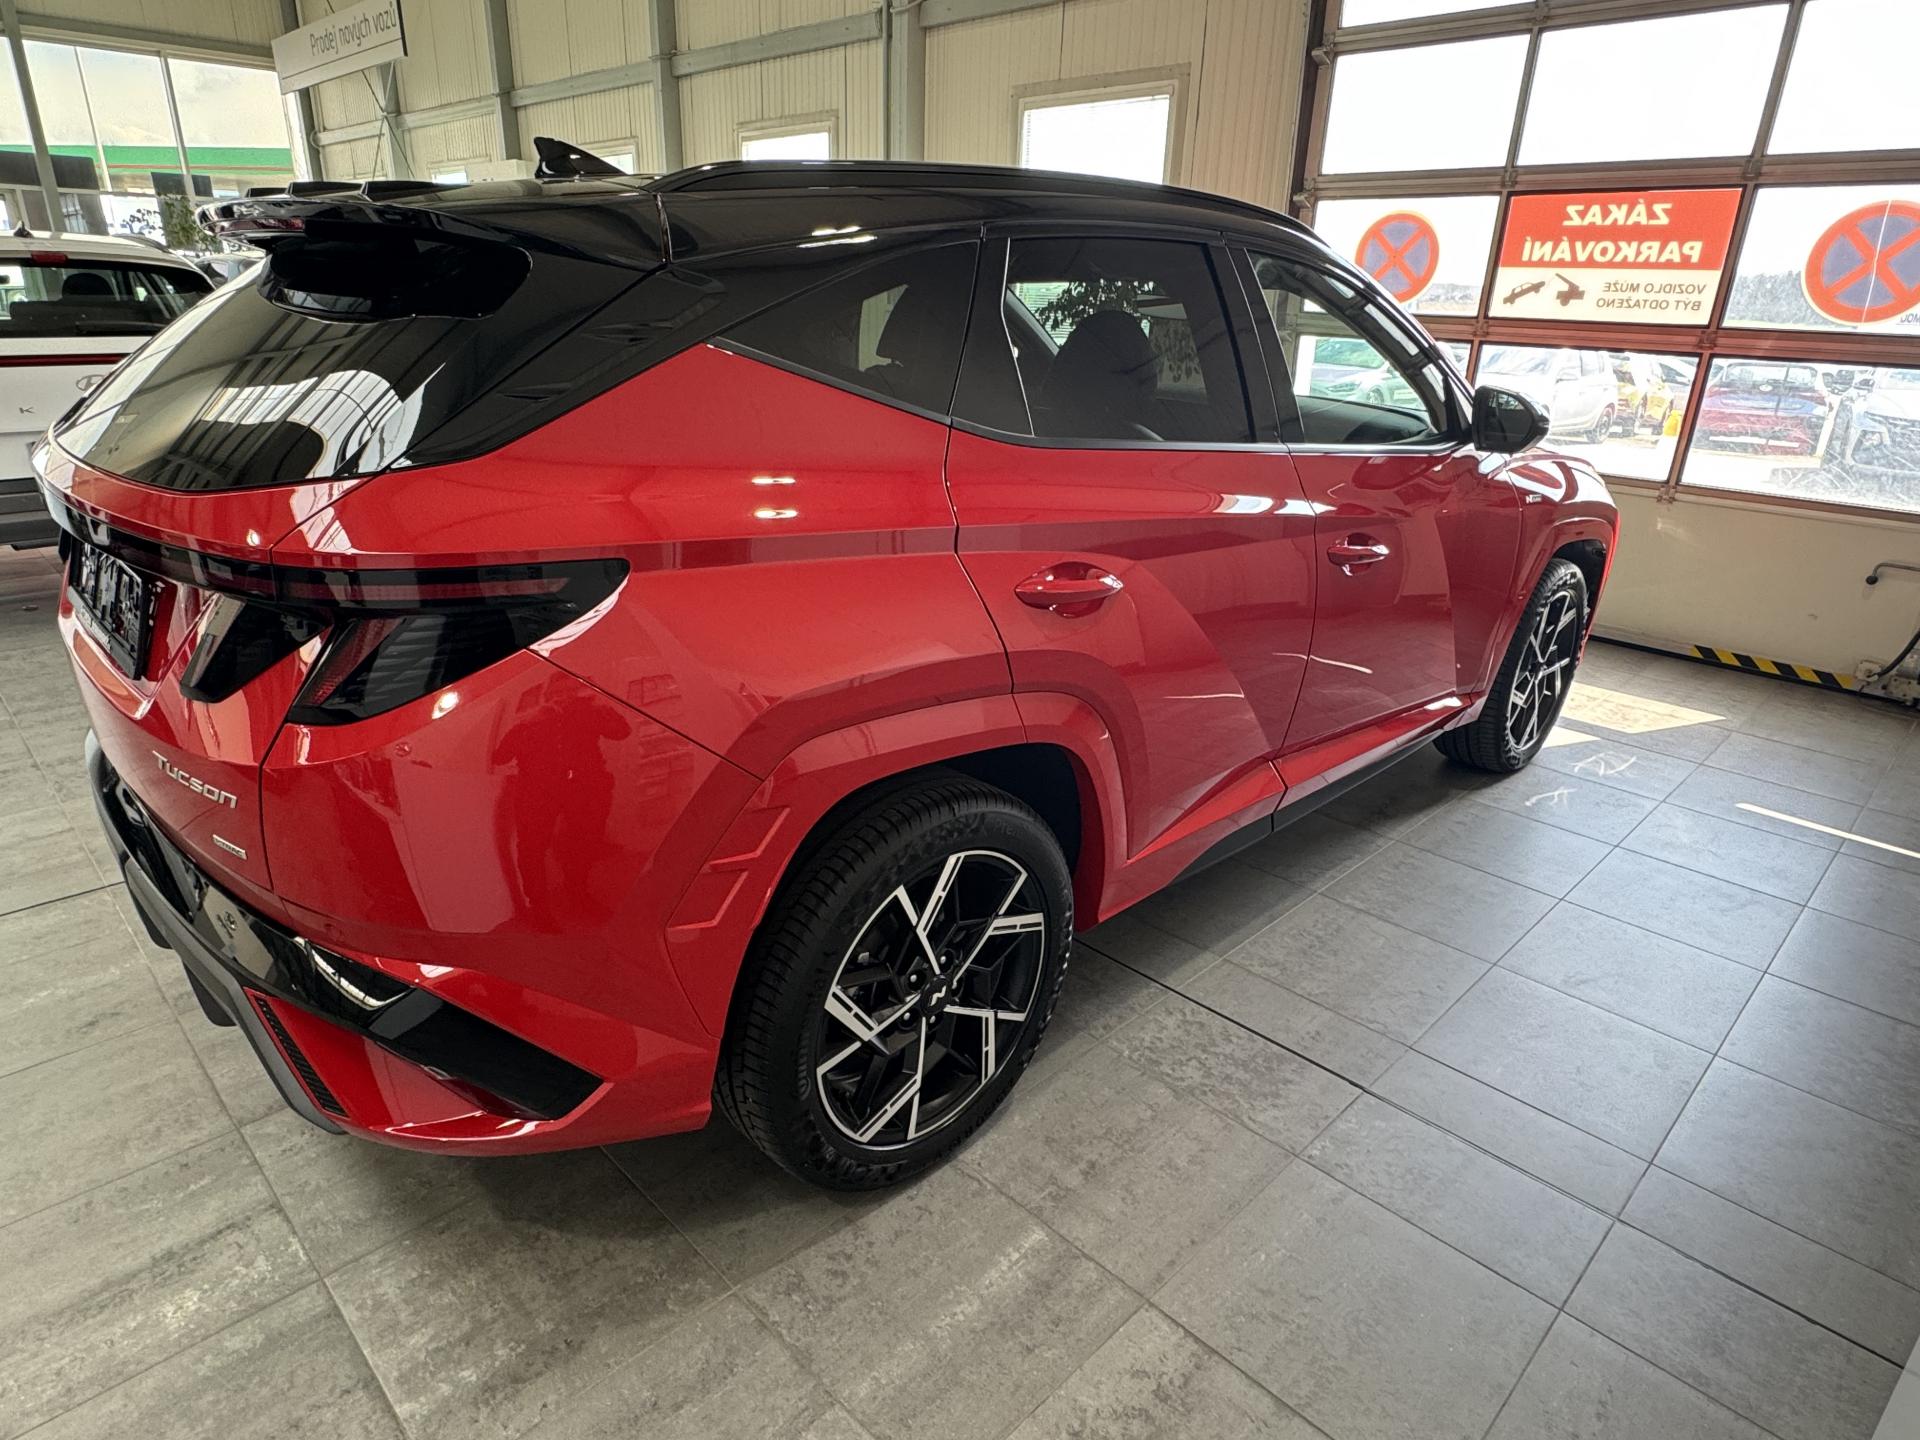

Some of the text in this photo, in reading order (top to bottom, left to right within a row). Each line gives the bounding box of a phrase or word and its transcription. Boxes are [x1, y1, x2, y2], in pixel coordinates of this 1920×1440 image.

[309, 1, 397, 56] Prodej nových vozů
